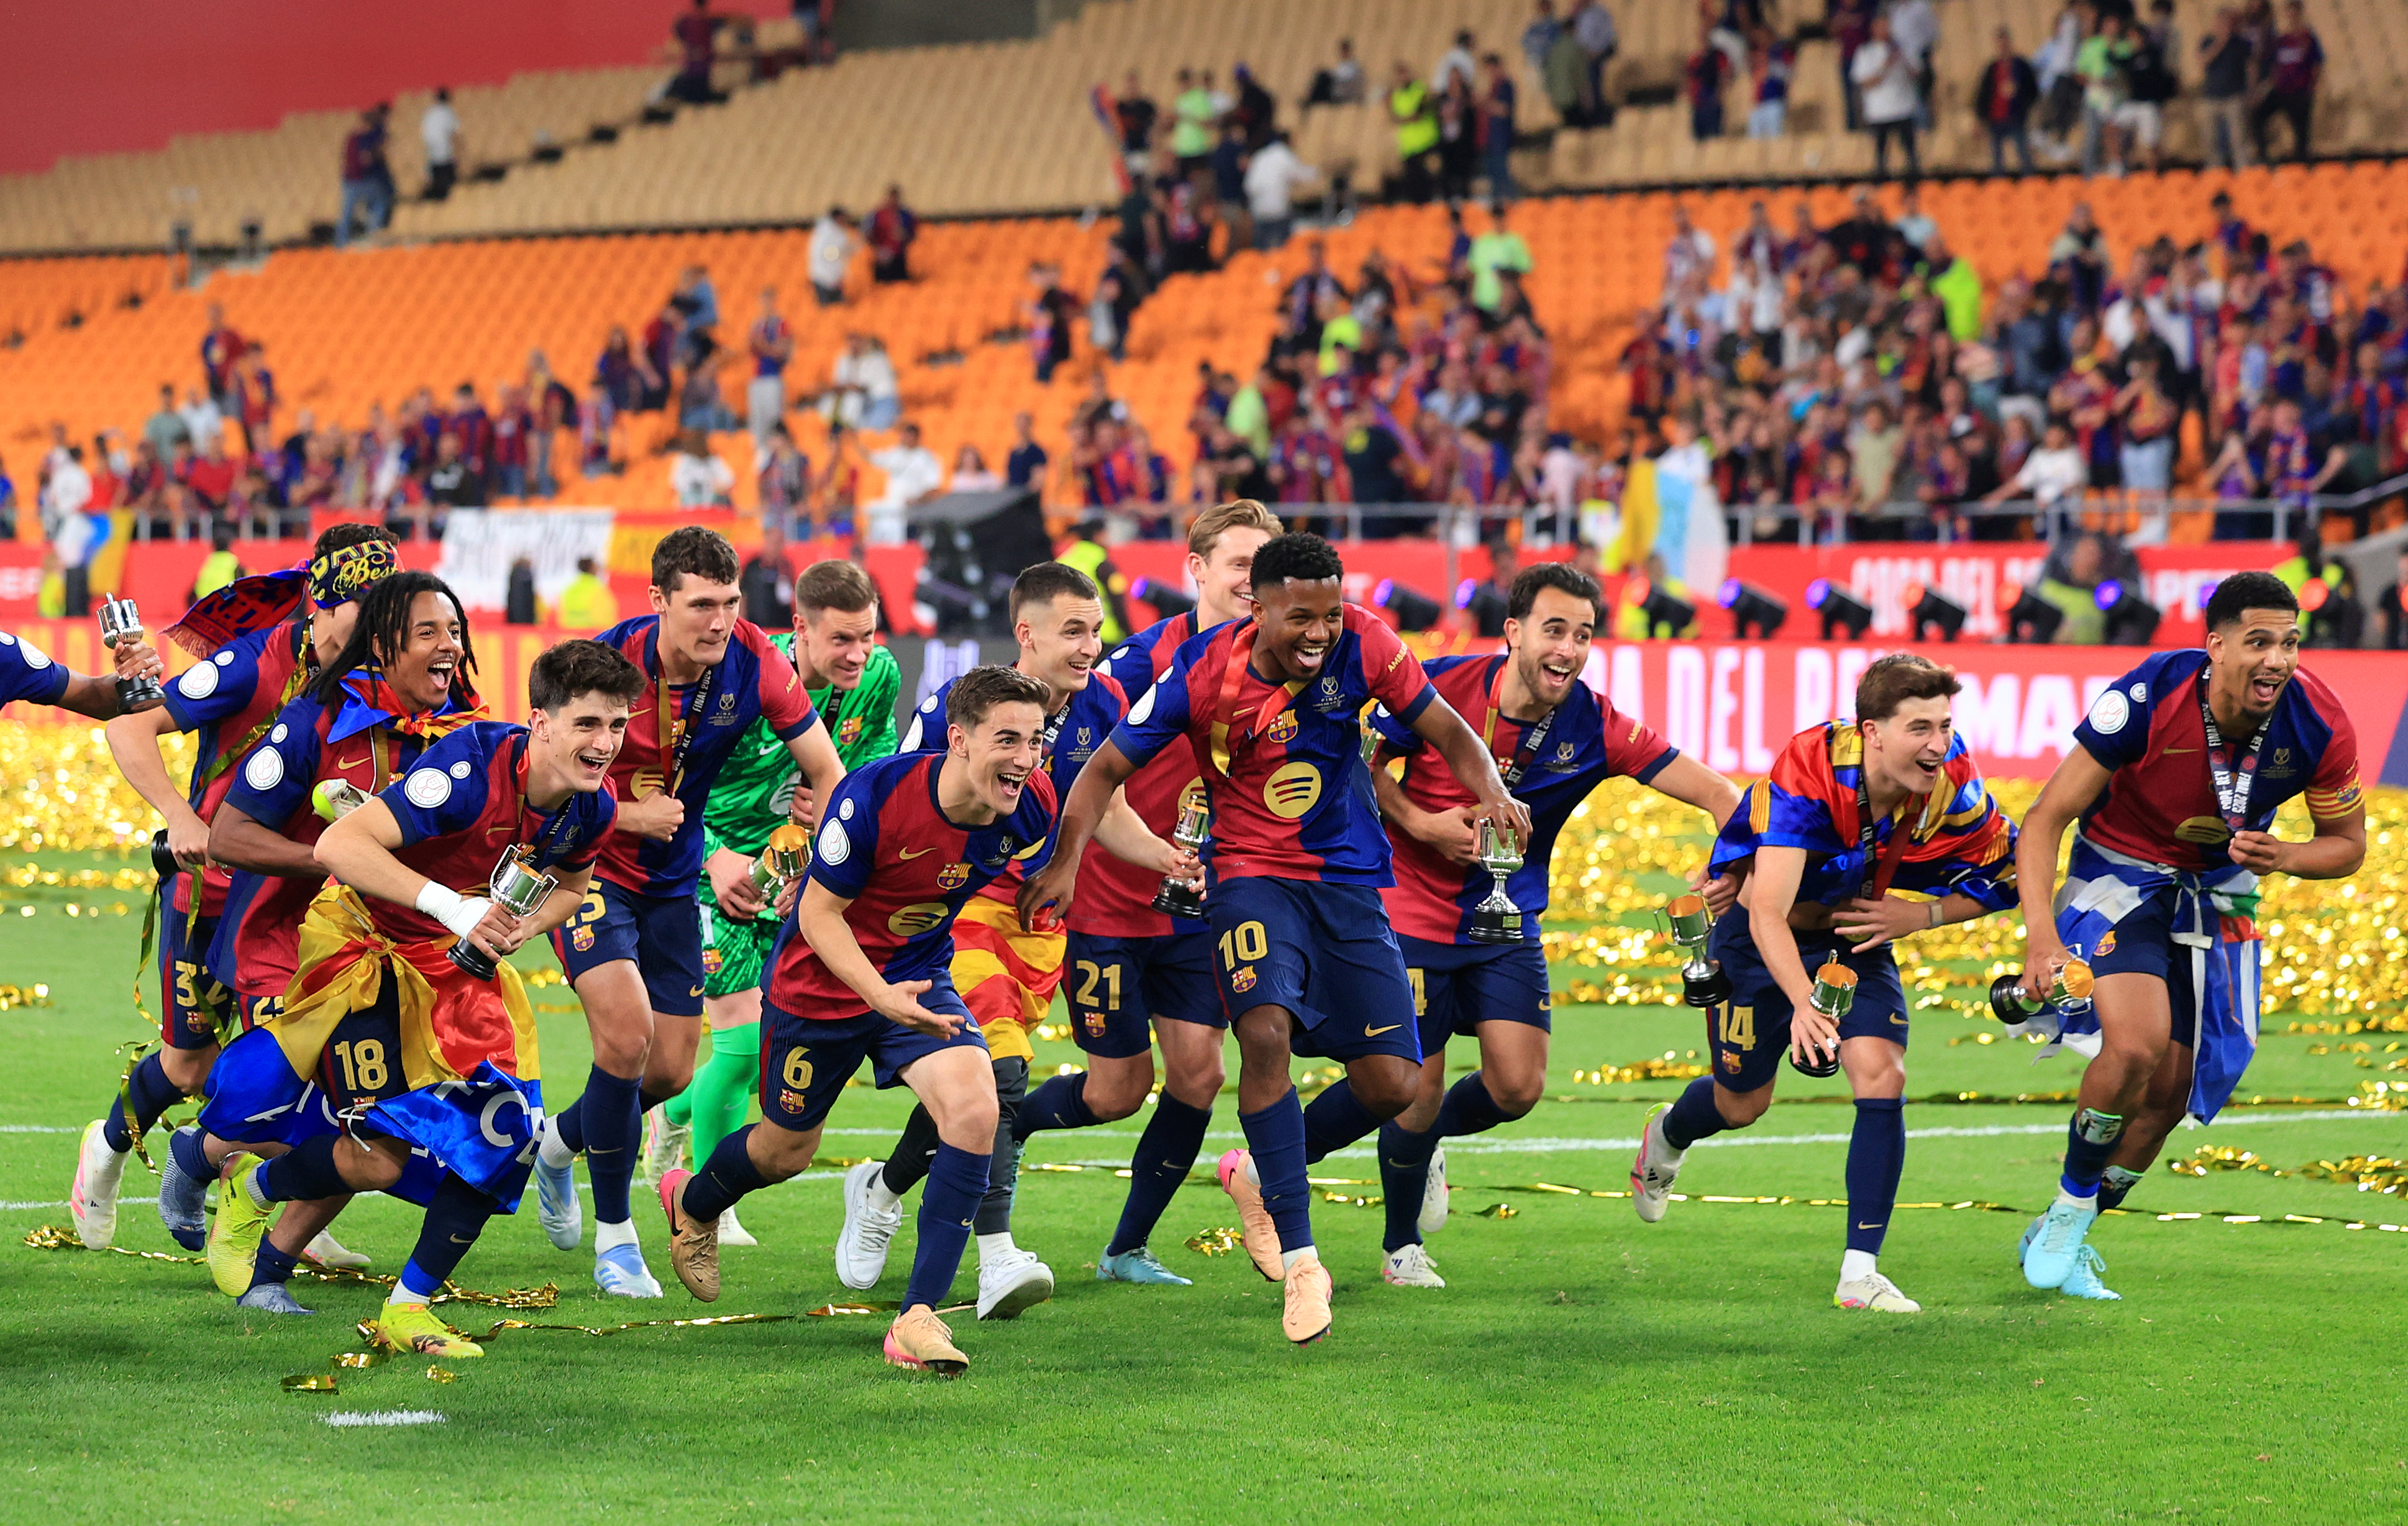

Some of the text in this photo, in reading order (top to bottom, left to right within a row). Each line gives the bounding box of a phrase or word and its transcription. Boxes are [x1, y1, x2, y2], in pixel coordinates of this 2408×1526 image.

[692, 690, 708, 713] FINAL
[1667, 646, 1773, 772] DEL
[1043, 704, 1070, 744] COPA REY
[2206, 725, 2223, 747] FINAL
[2213, 770, 2233, 811] COPA REY
[2231, 772, 2252, 815] FINAL 2025
[1218, 920, 1268, 972] 10
[1075, 960, 1121, 1011] 21
[1714, 999, 1756, 1051] 14
[334, 1038, 388, 1091] 18
[783, 1046, 814, 1090] 6
